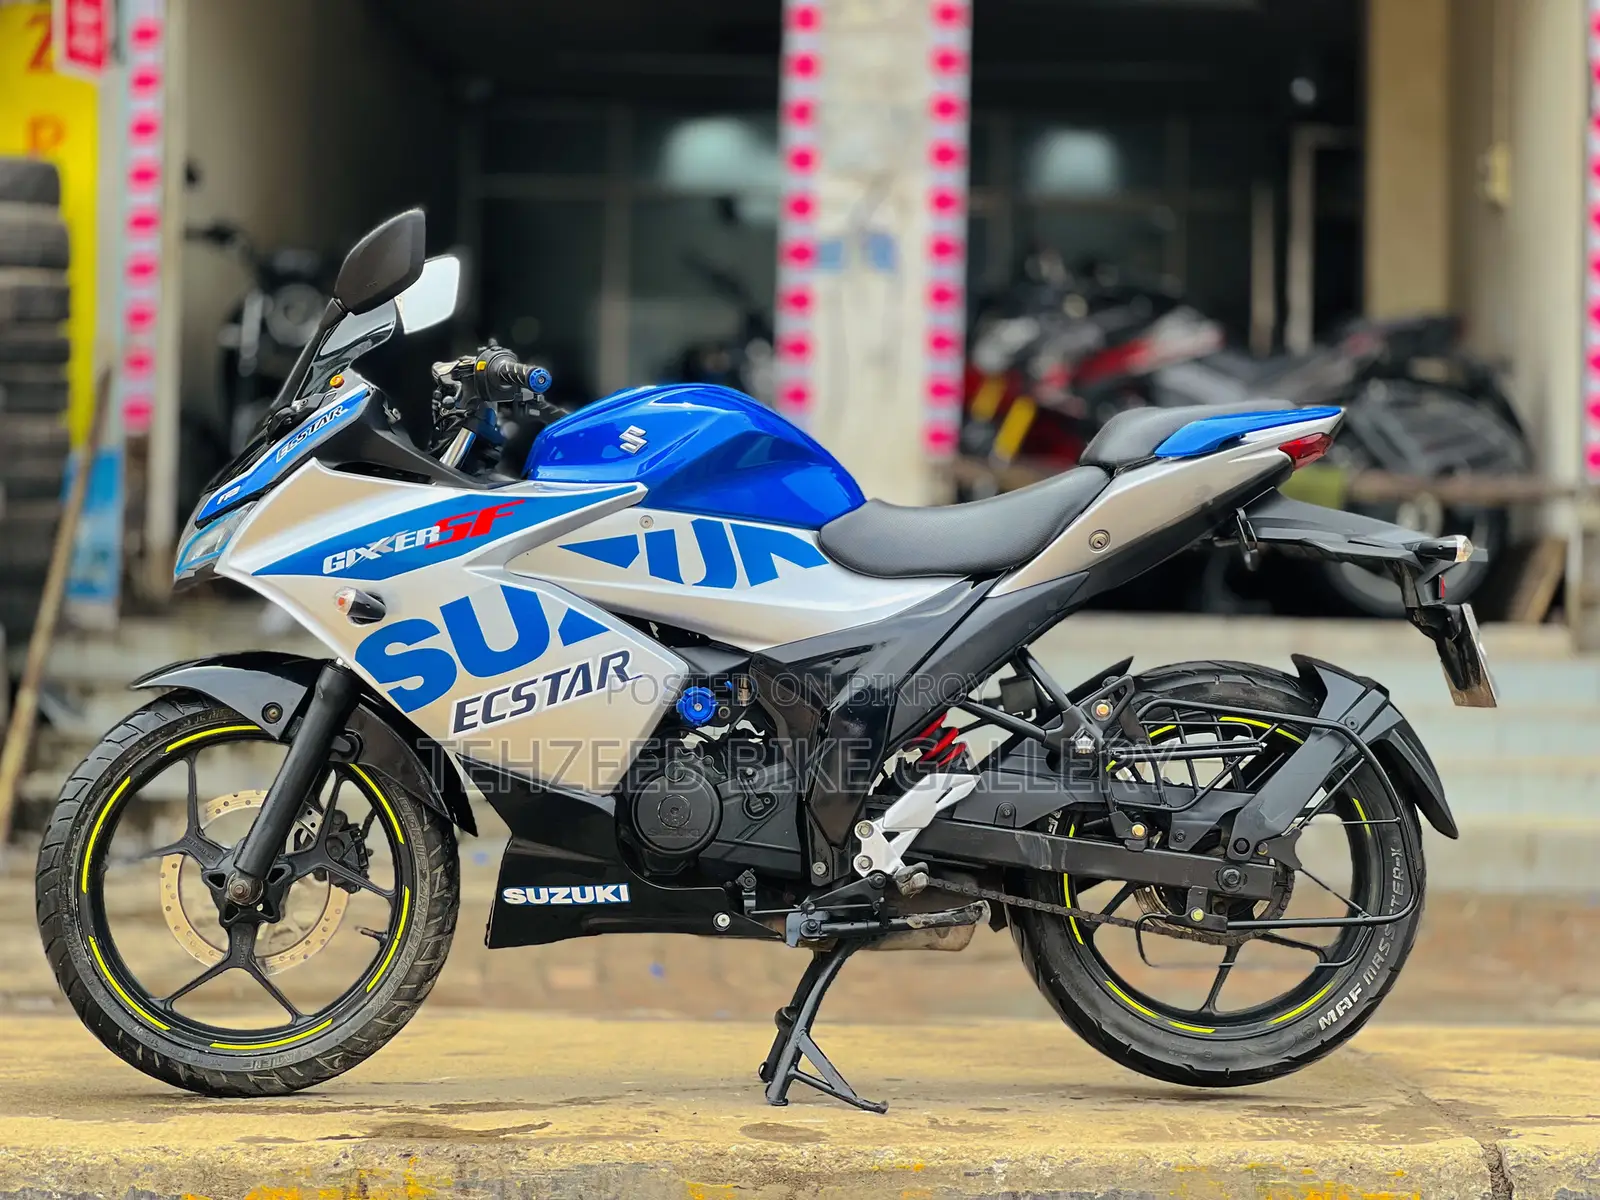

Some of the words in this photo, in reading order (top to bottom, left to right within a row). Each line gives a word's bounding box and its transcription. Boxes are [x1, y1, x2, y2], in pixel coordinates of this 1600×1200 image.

[275, 404, 350, 463] ECSTAR
[424, 499, 526, 549] SF
[452, 650, 643, 735] ECSTAR
[502, 884, 630, 905] SUZUKI
[1318, 982, 1363, 1032] MAF
